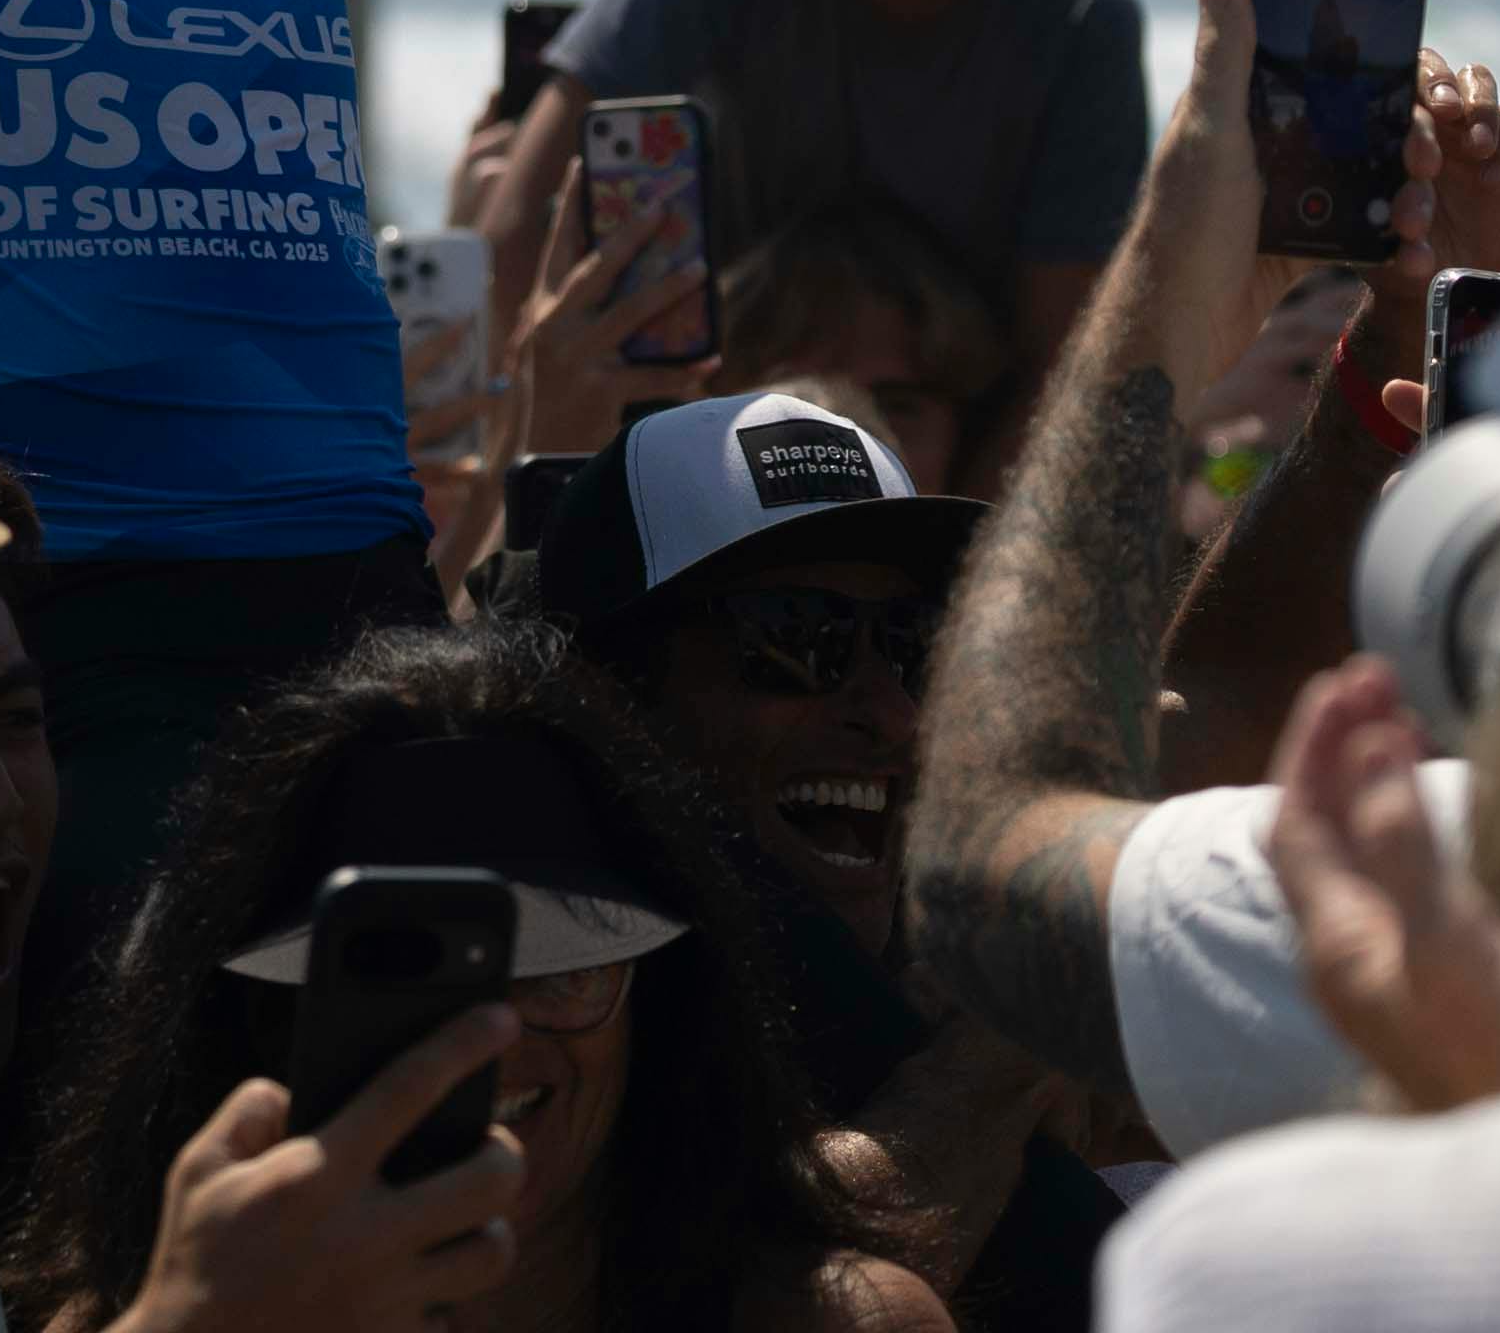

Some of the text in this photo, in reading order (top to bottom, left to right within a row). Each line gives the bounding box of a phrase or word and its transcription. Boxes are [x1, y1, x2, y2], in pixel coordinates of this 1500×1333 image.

[71, 186, 321, 237] SURFING
[157, 237, 247, 262] BEACH,
[248, 241, 278, 262] CA
[282, 241, 330, 264] 2025
[759, 444, 864, 465] sharpeye
[764, 462, 870, 480] surfboards
